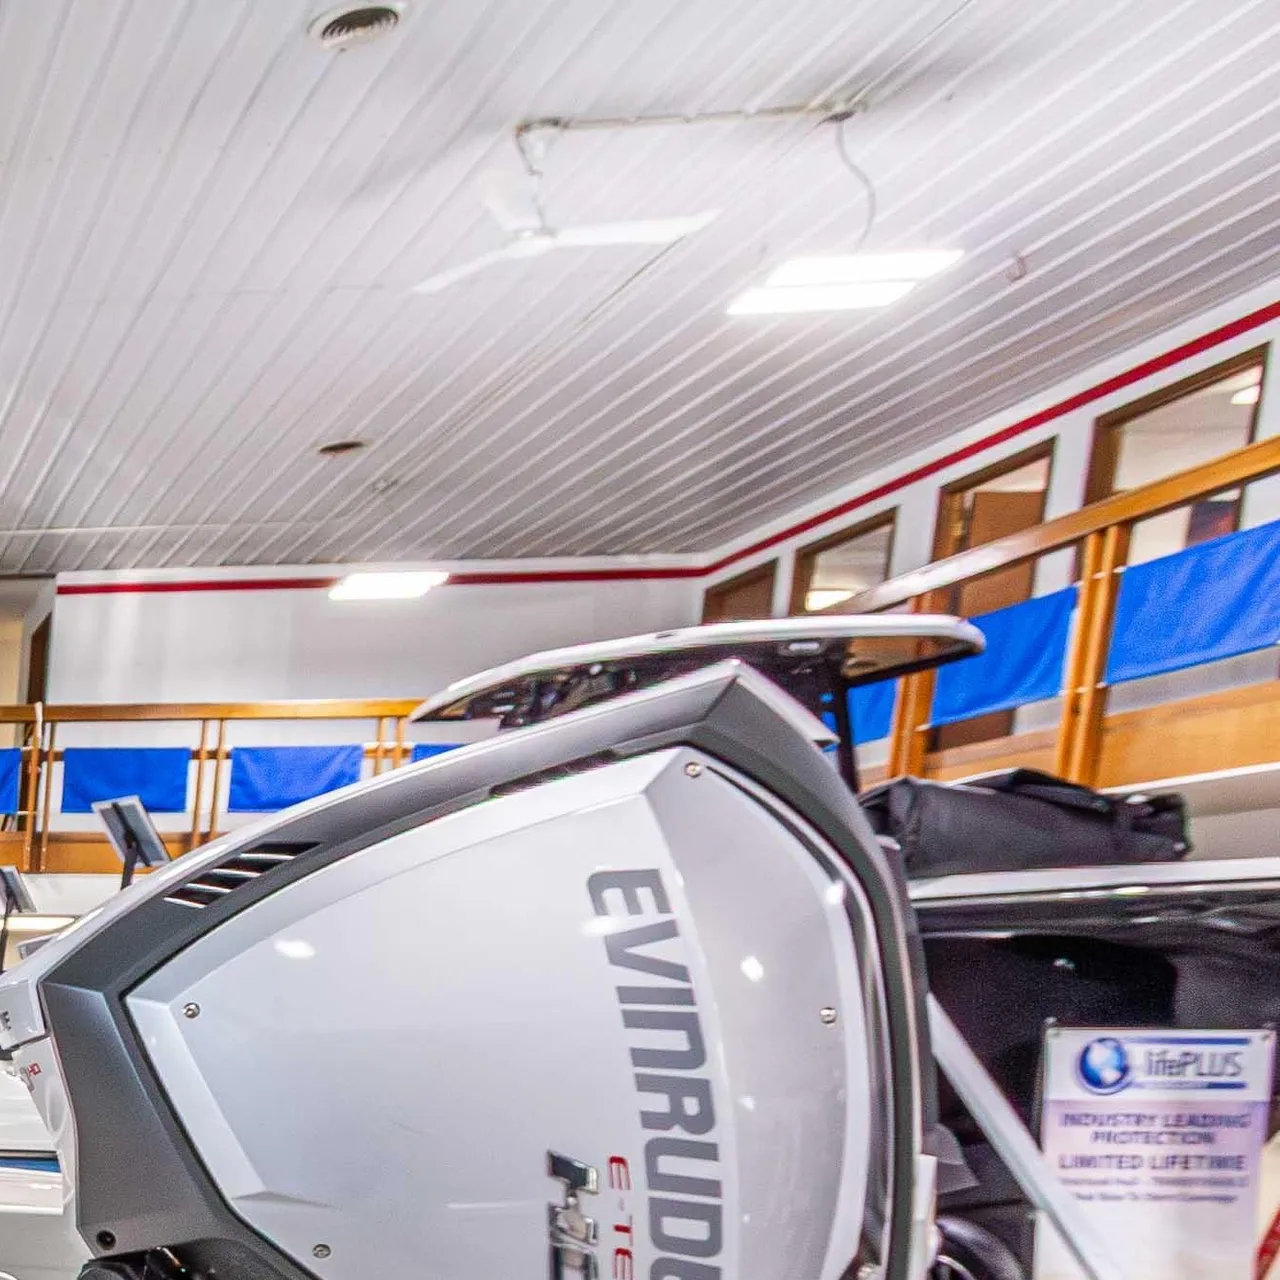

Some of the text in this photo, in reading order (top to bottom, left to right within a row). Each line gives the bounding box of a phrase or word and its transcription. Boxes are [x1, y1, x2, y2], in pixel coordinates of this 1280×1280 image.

[1144, 1050, 1244, 1078] lifePLUS
[1060, 1113, 1252, 1129] INDUSTRY LEADING
[1091, 1131, 1216, 1145] PROTECTION
[1058, 1154, 1247, 1170] LIMITED LIFETIME
